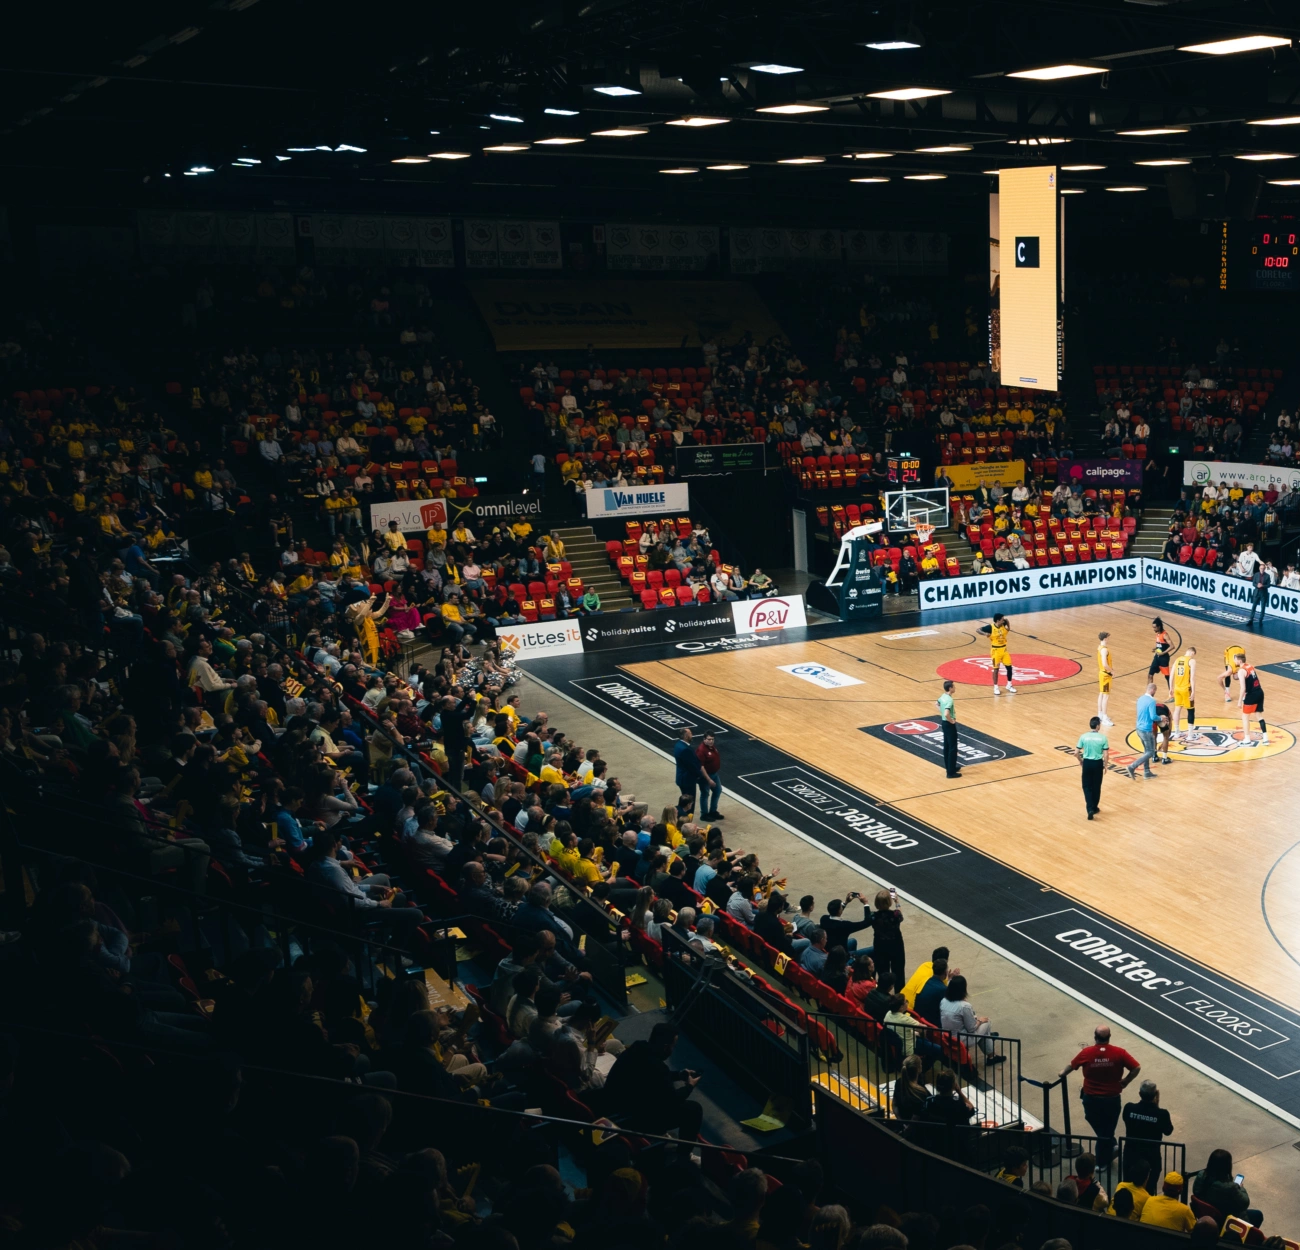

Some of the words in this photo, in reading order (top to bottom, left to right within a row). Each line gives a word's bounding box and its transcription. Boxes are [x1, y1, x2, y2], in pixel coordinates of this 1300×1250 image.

[1263, 233, 1270, 244] 0
[1288, 233, 1295, 244] 0
[1017, 242, 1026, 262] C
[1264, 256, 1289, 267] 10:00
[493, 302, 634, 316] DUSAN
[901, 460, 920, 469] 10:00
[902, 469, 917, 483] 24
[1219, 472, 1282, 484] www.arq.be
[613, 492, 633, 508] VAN
[635, 492, 665, 505] HUELE
[474, 503, 541, 518] omnilevel
[924, 575, 1031, 603] CHAMPIONS
[1039, 563, 1137, 589] CHAMPIONS
[1145, 564, 1216, 594] CHAMPIONS
[678, 617, 731, 629] holidaysuites
[755, 609, 789, 628] P&V
[601, 625, 657, 637] holidaysuites
[1185, 998, 1262, 1037] FLOORS
[1129, 1112, 1158, 1123] STEWARD
